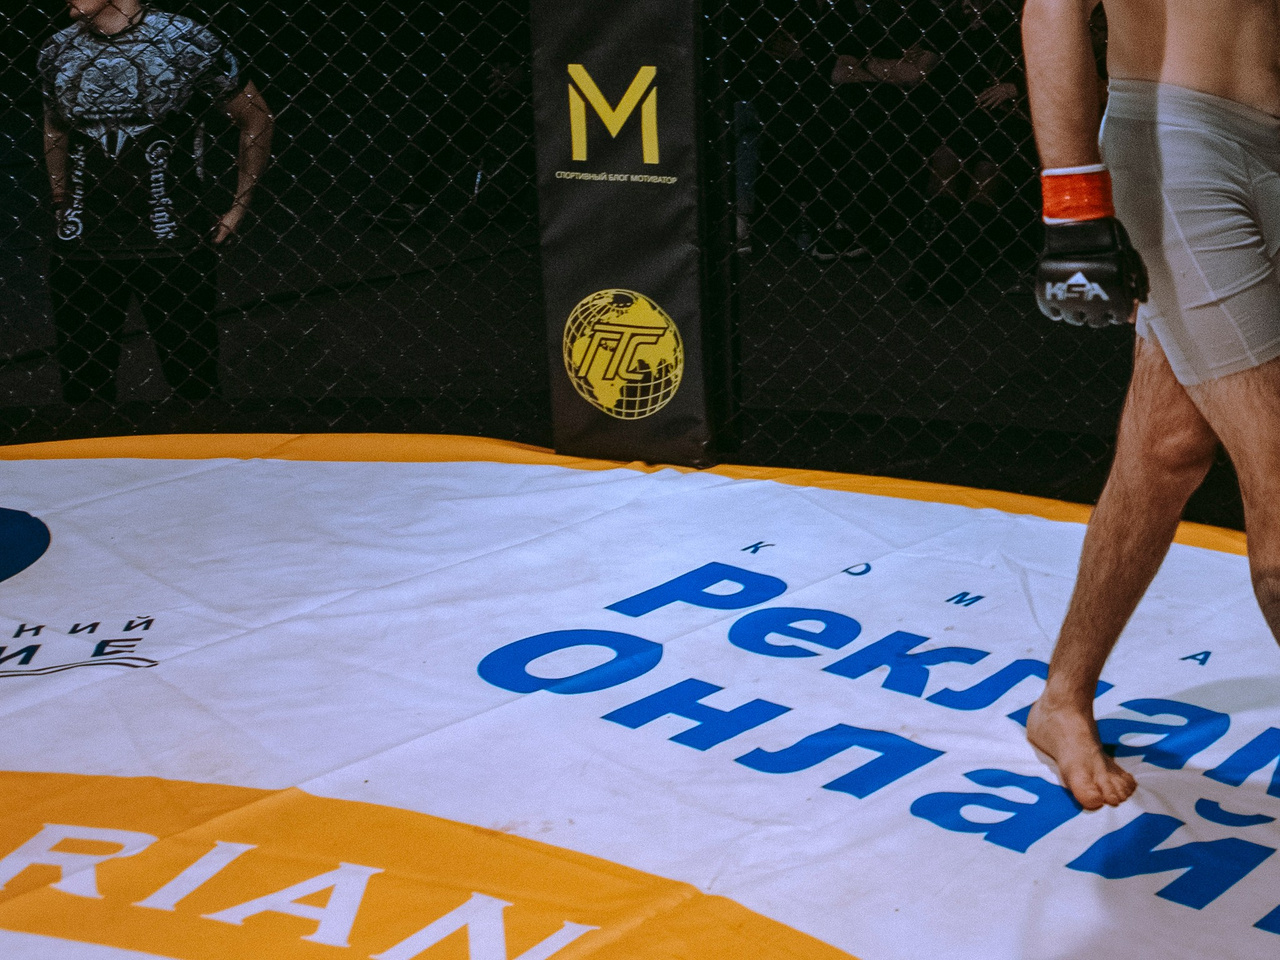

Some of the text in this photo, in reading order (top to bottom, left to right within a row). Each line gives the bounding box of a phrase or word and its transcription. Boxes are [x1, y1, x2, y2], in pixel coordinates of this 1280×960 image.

[555, 171, 678, 184] СПОРТИВНЫЙ БЛОГ МОТИВАТОР
